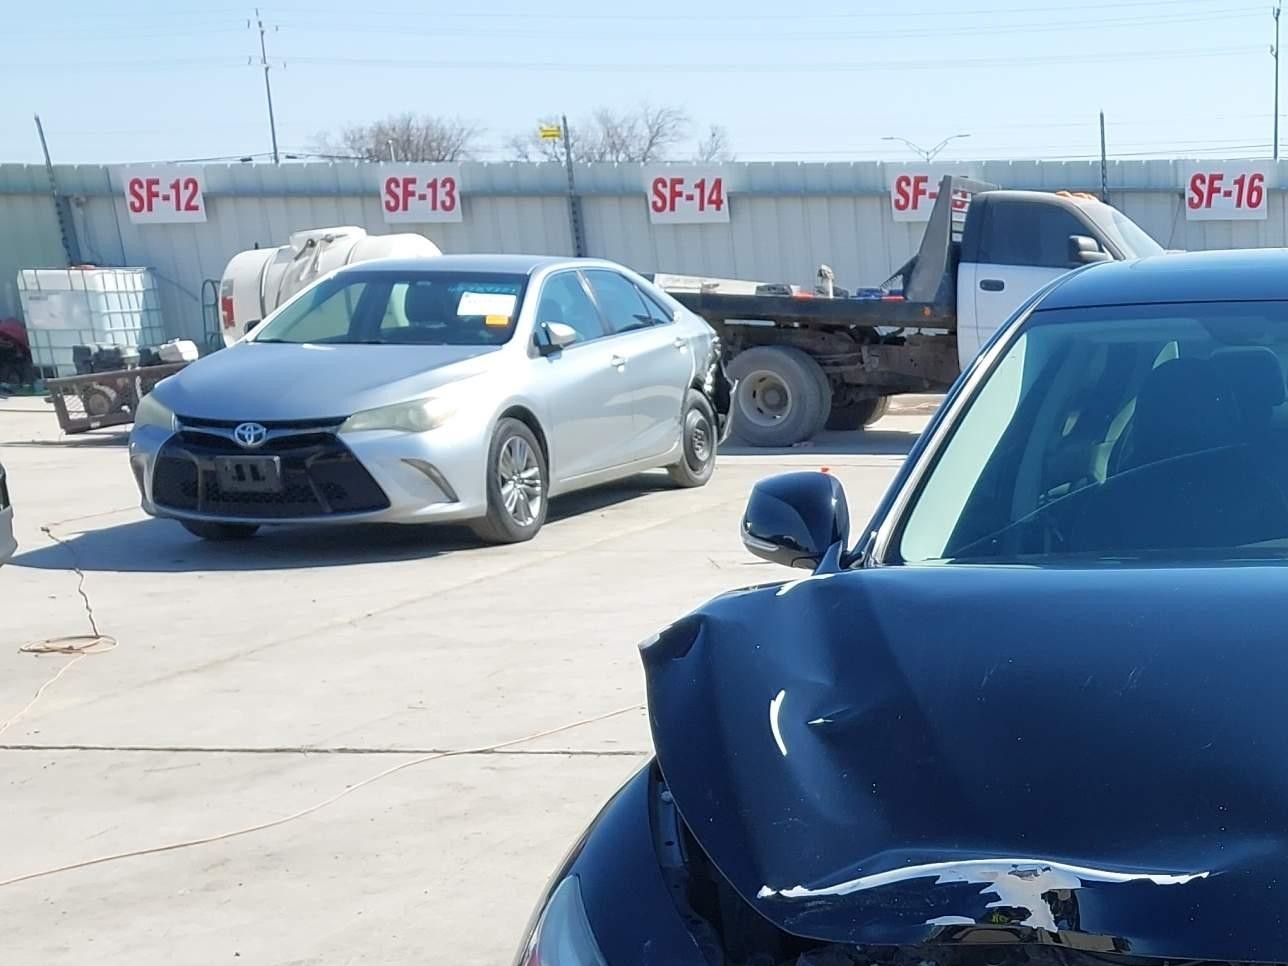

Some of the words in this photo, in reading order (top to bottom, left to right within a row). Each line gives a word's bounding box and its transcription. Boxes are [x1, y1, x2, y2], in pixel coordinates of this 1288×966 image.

[129, 178, 199, 213] SF-12
[384, 177, 456, 212] SF-13
[652, 177, 724, 212] SF-14
[894, 175, 968, 211] SF-
[1188, 173, 1264, 209] SF-16
